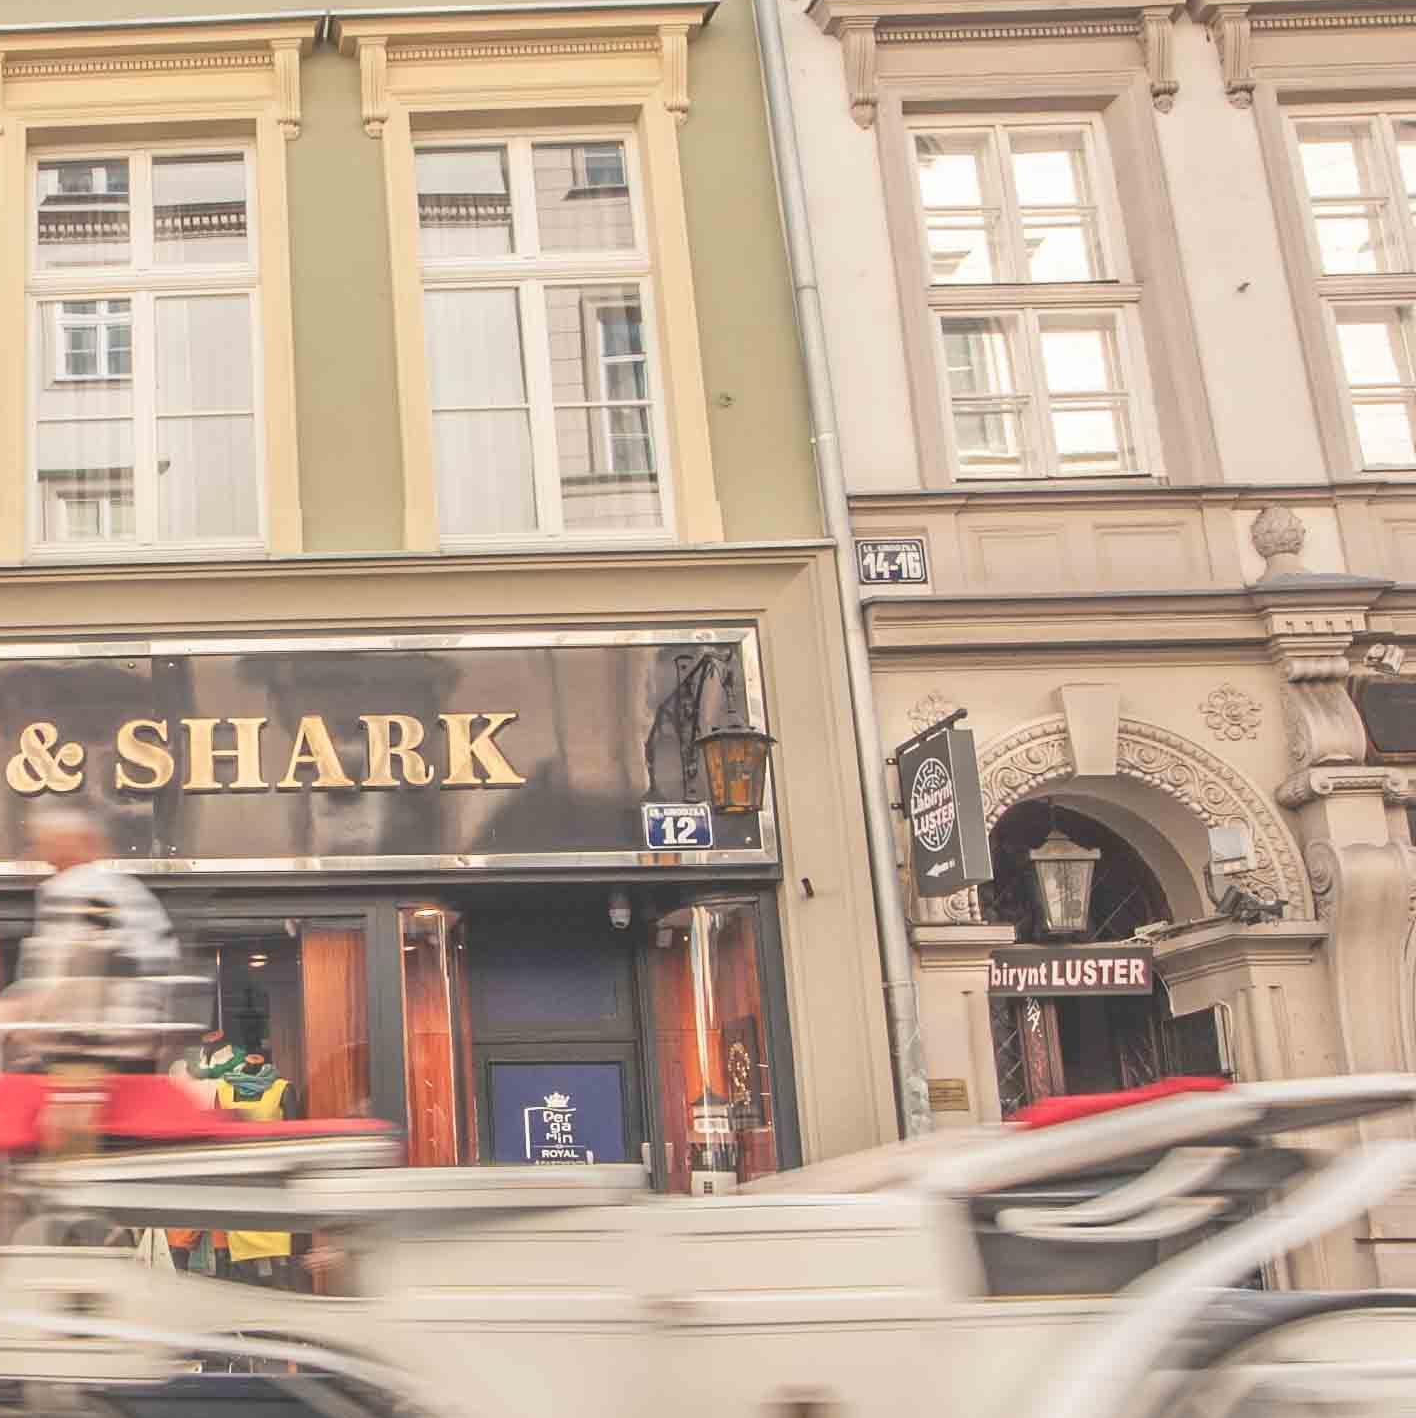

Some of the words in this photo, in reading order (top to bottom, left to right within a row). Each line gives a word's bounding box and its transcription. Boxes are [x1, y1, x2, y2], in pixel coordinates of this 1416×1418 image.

[862, 551, 923, 579] 14-16
[5, 721, 86, 796] &
[114, 712, 528, 792] SHARK
[661, 816, 697, 845] 12
[912, 802, 955, 837] LUSTER
[985, 958, 1048, 992] birynt
[1051, 958, 1145, 986] LUSTER
[541, 1148, 580, 1158] ROYAL
